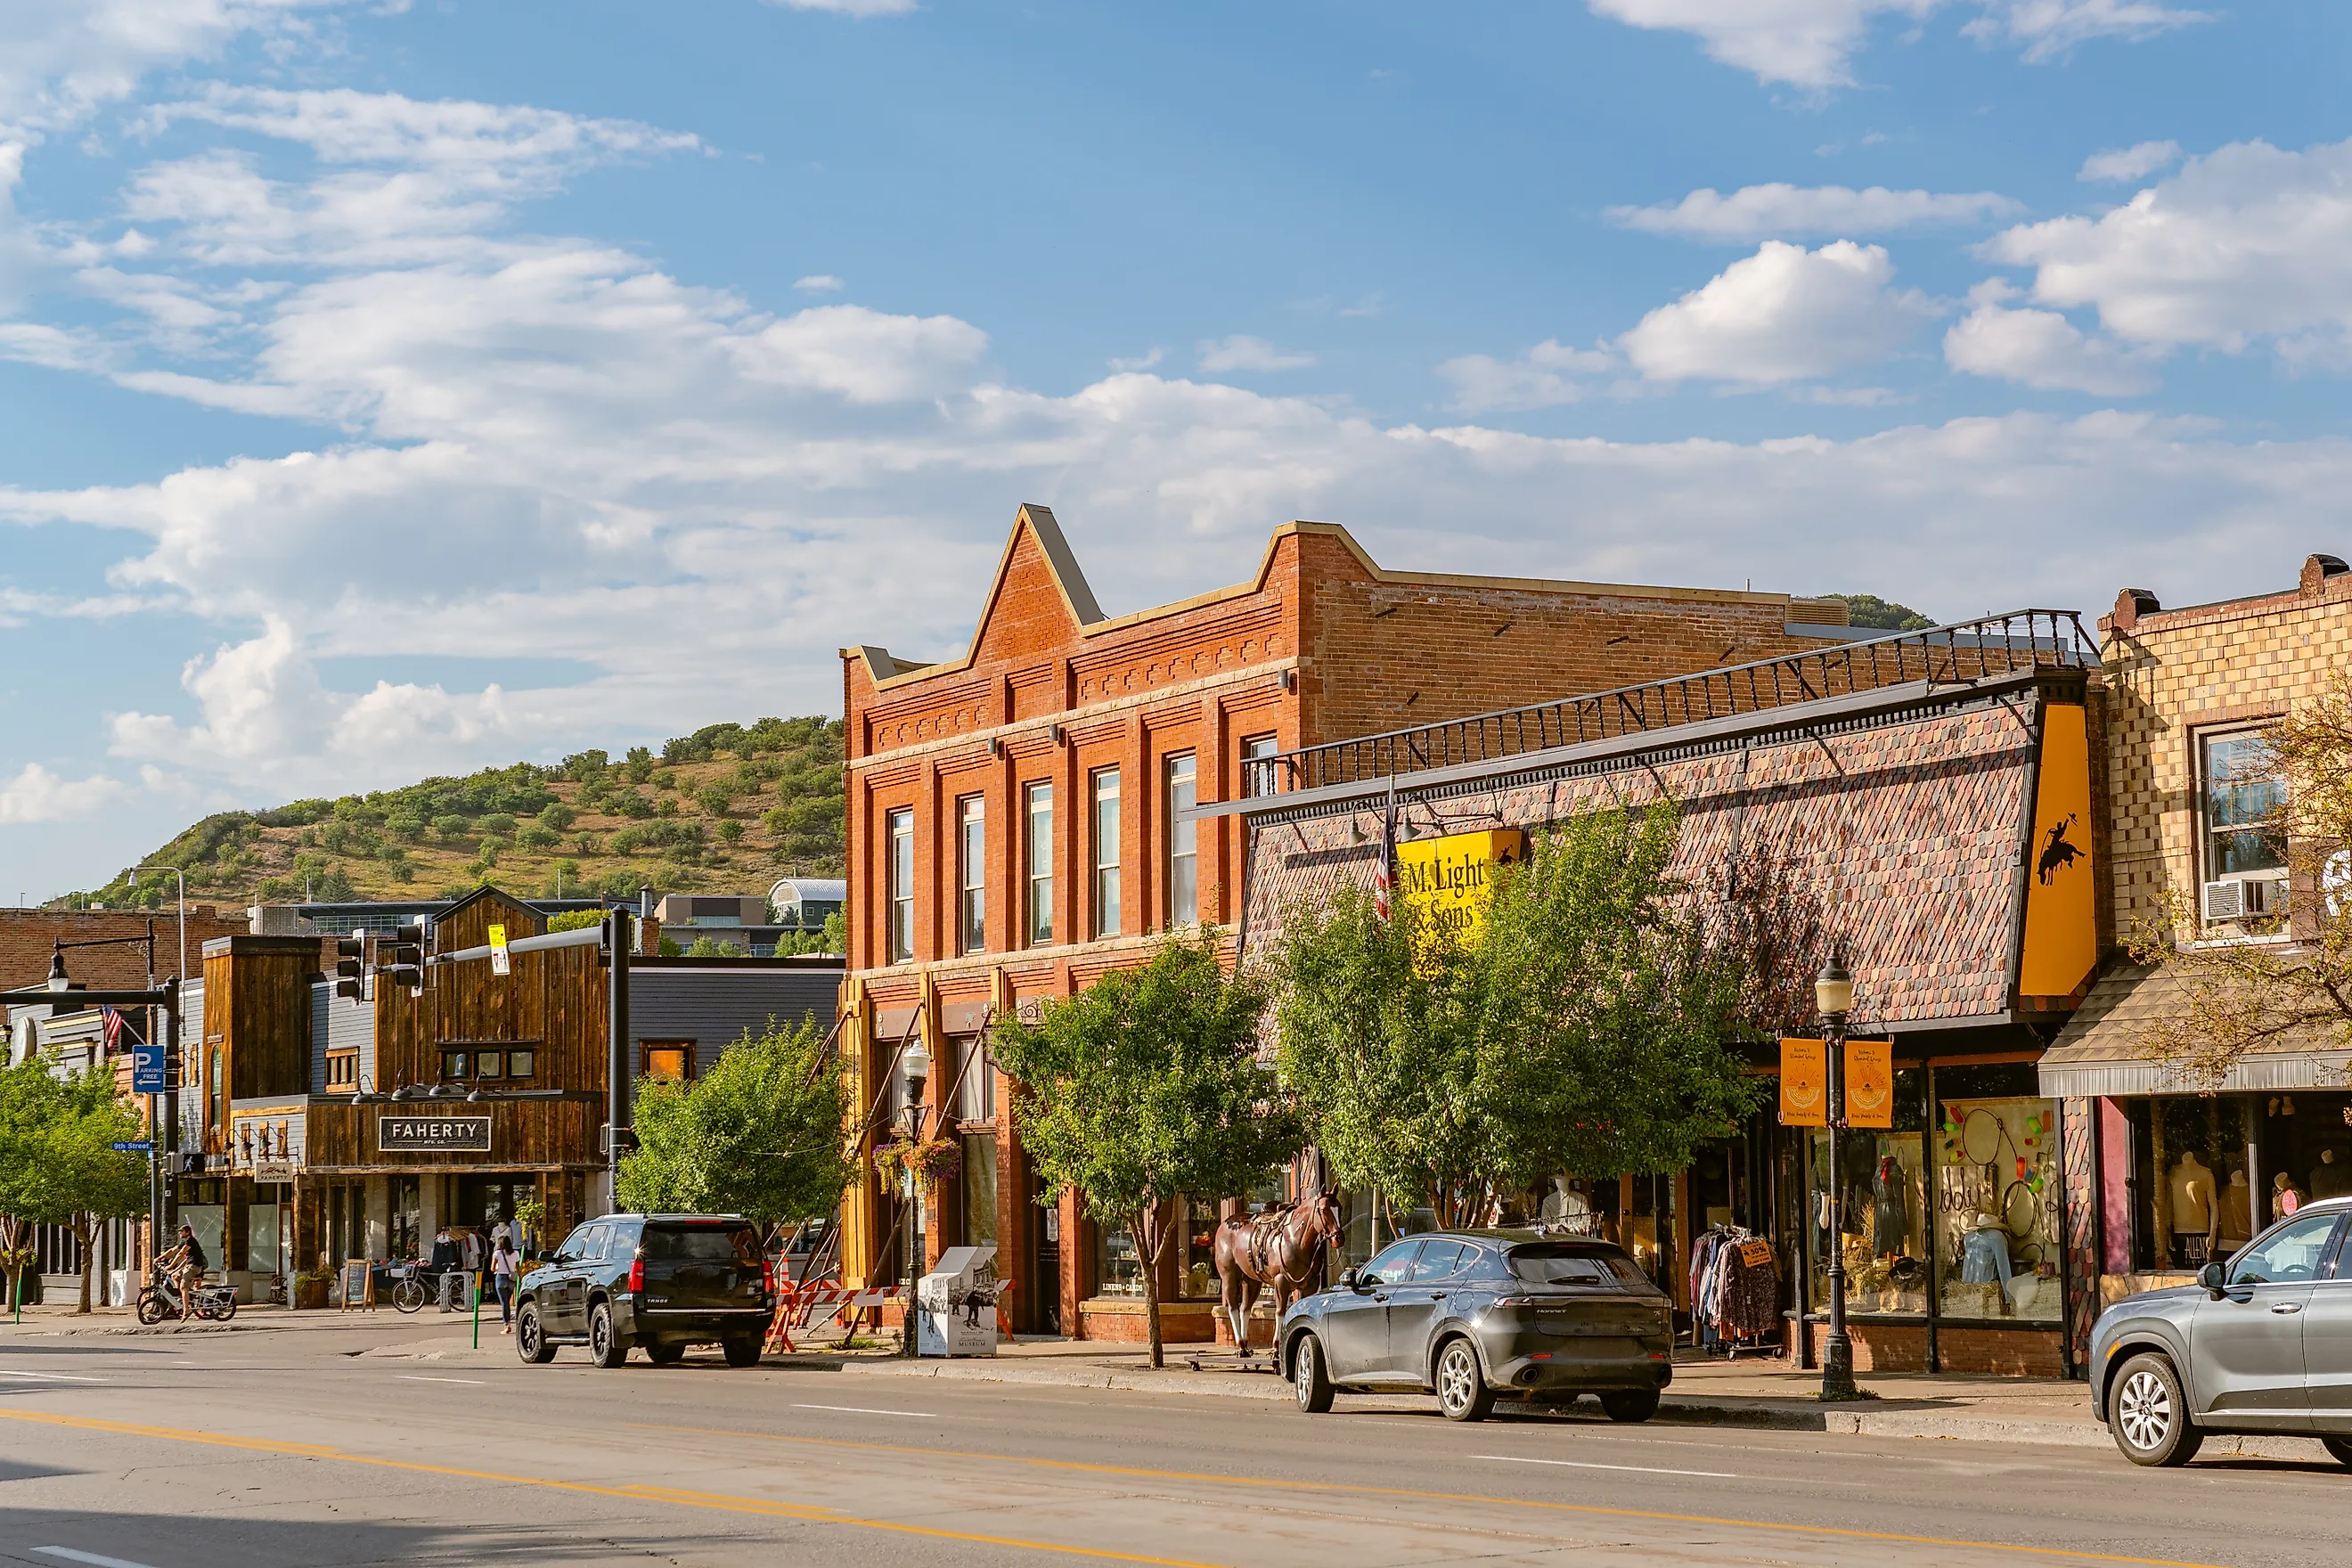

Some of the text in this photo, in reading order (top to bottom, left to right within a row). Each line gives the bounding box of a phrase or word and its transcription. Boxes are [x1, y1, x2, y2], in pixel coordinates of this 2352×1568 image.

[1434, 853, 1484, 899] Light
[1430, 898, 1474, 933] Sons
[135, 1052, 163, 1074] PARKING
[392, 1123, 478, 1138] FAHERTY
[113, 1141, 151, 1150] 9th Street
[1102, 1283, 1143, 1292] LINENS CARDS
